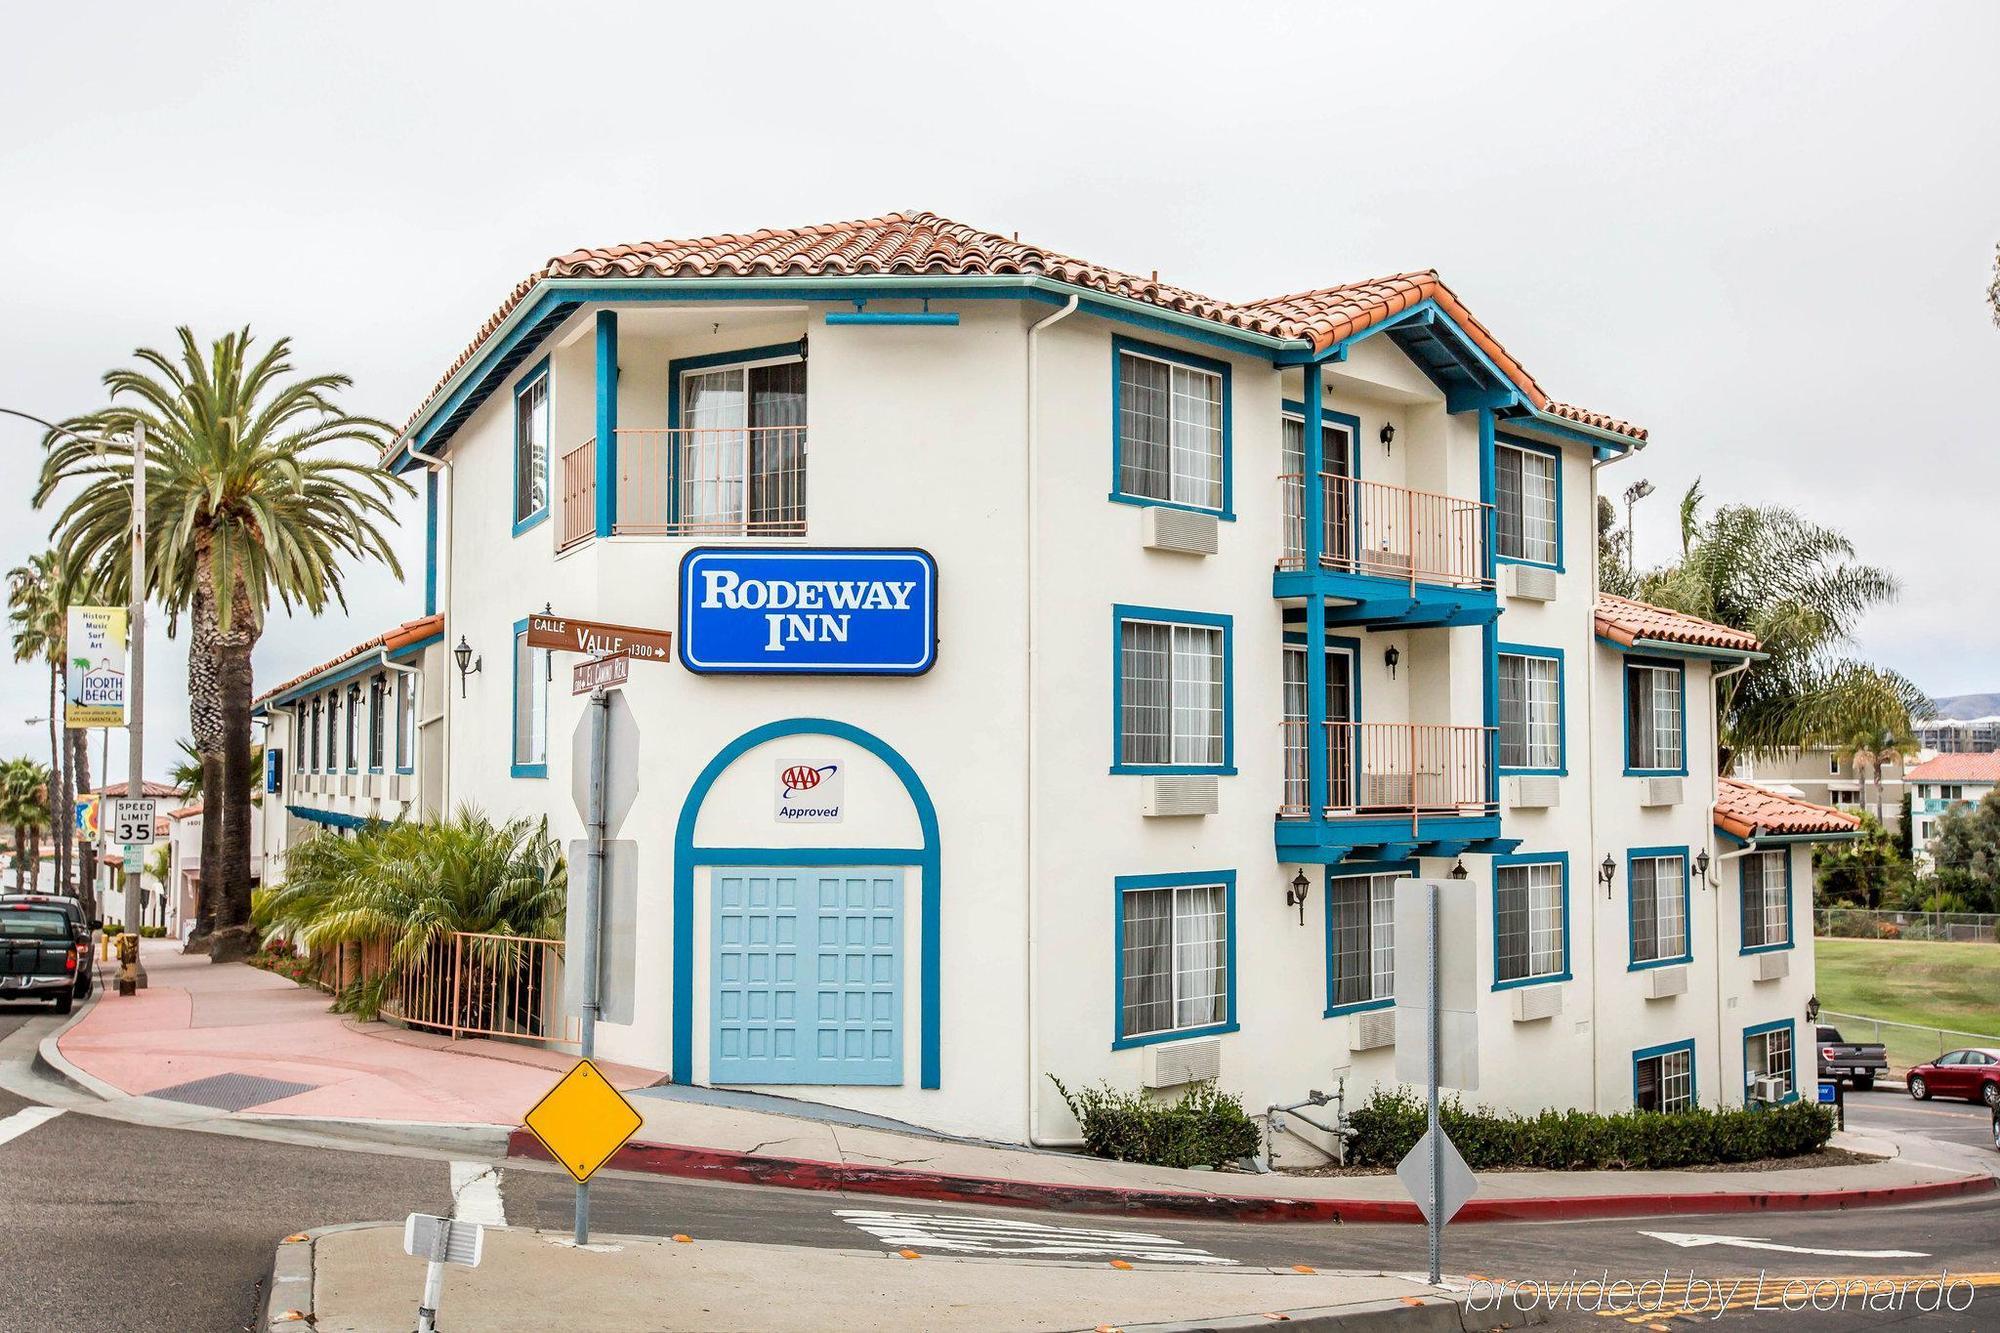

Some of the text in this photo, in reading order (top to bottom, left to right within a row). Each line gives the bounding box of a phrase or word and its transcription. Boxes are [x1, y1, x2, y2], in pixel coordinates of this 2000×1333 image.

[701, 570, 916, 610] RODEWAY
[83, 612, 111, 621] History
[534, 618, 653, 657] CALLE VALLE 1300
[764, 614, 851, 651] INN
[90, 641, 102, 649] Art
[85, 677, 123, 689] NORTH
[85, 689, 123, 701] BEACH
[785, 765, 817, 790] AAA
[118, 803, 153, 811] SPEED
[779, 806, 839, 819] Approved
[121, 813, 150, 821] LIMIT
[119, 824, 150, 840] 35
